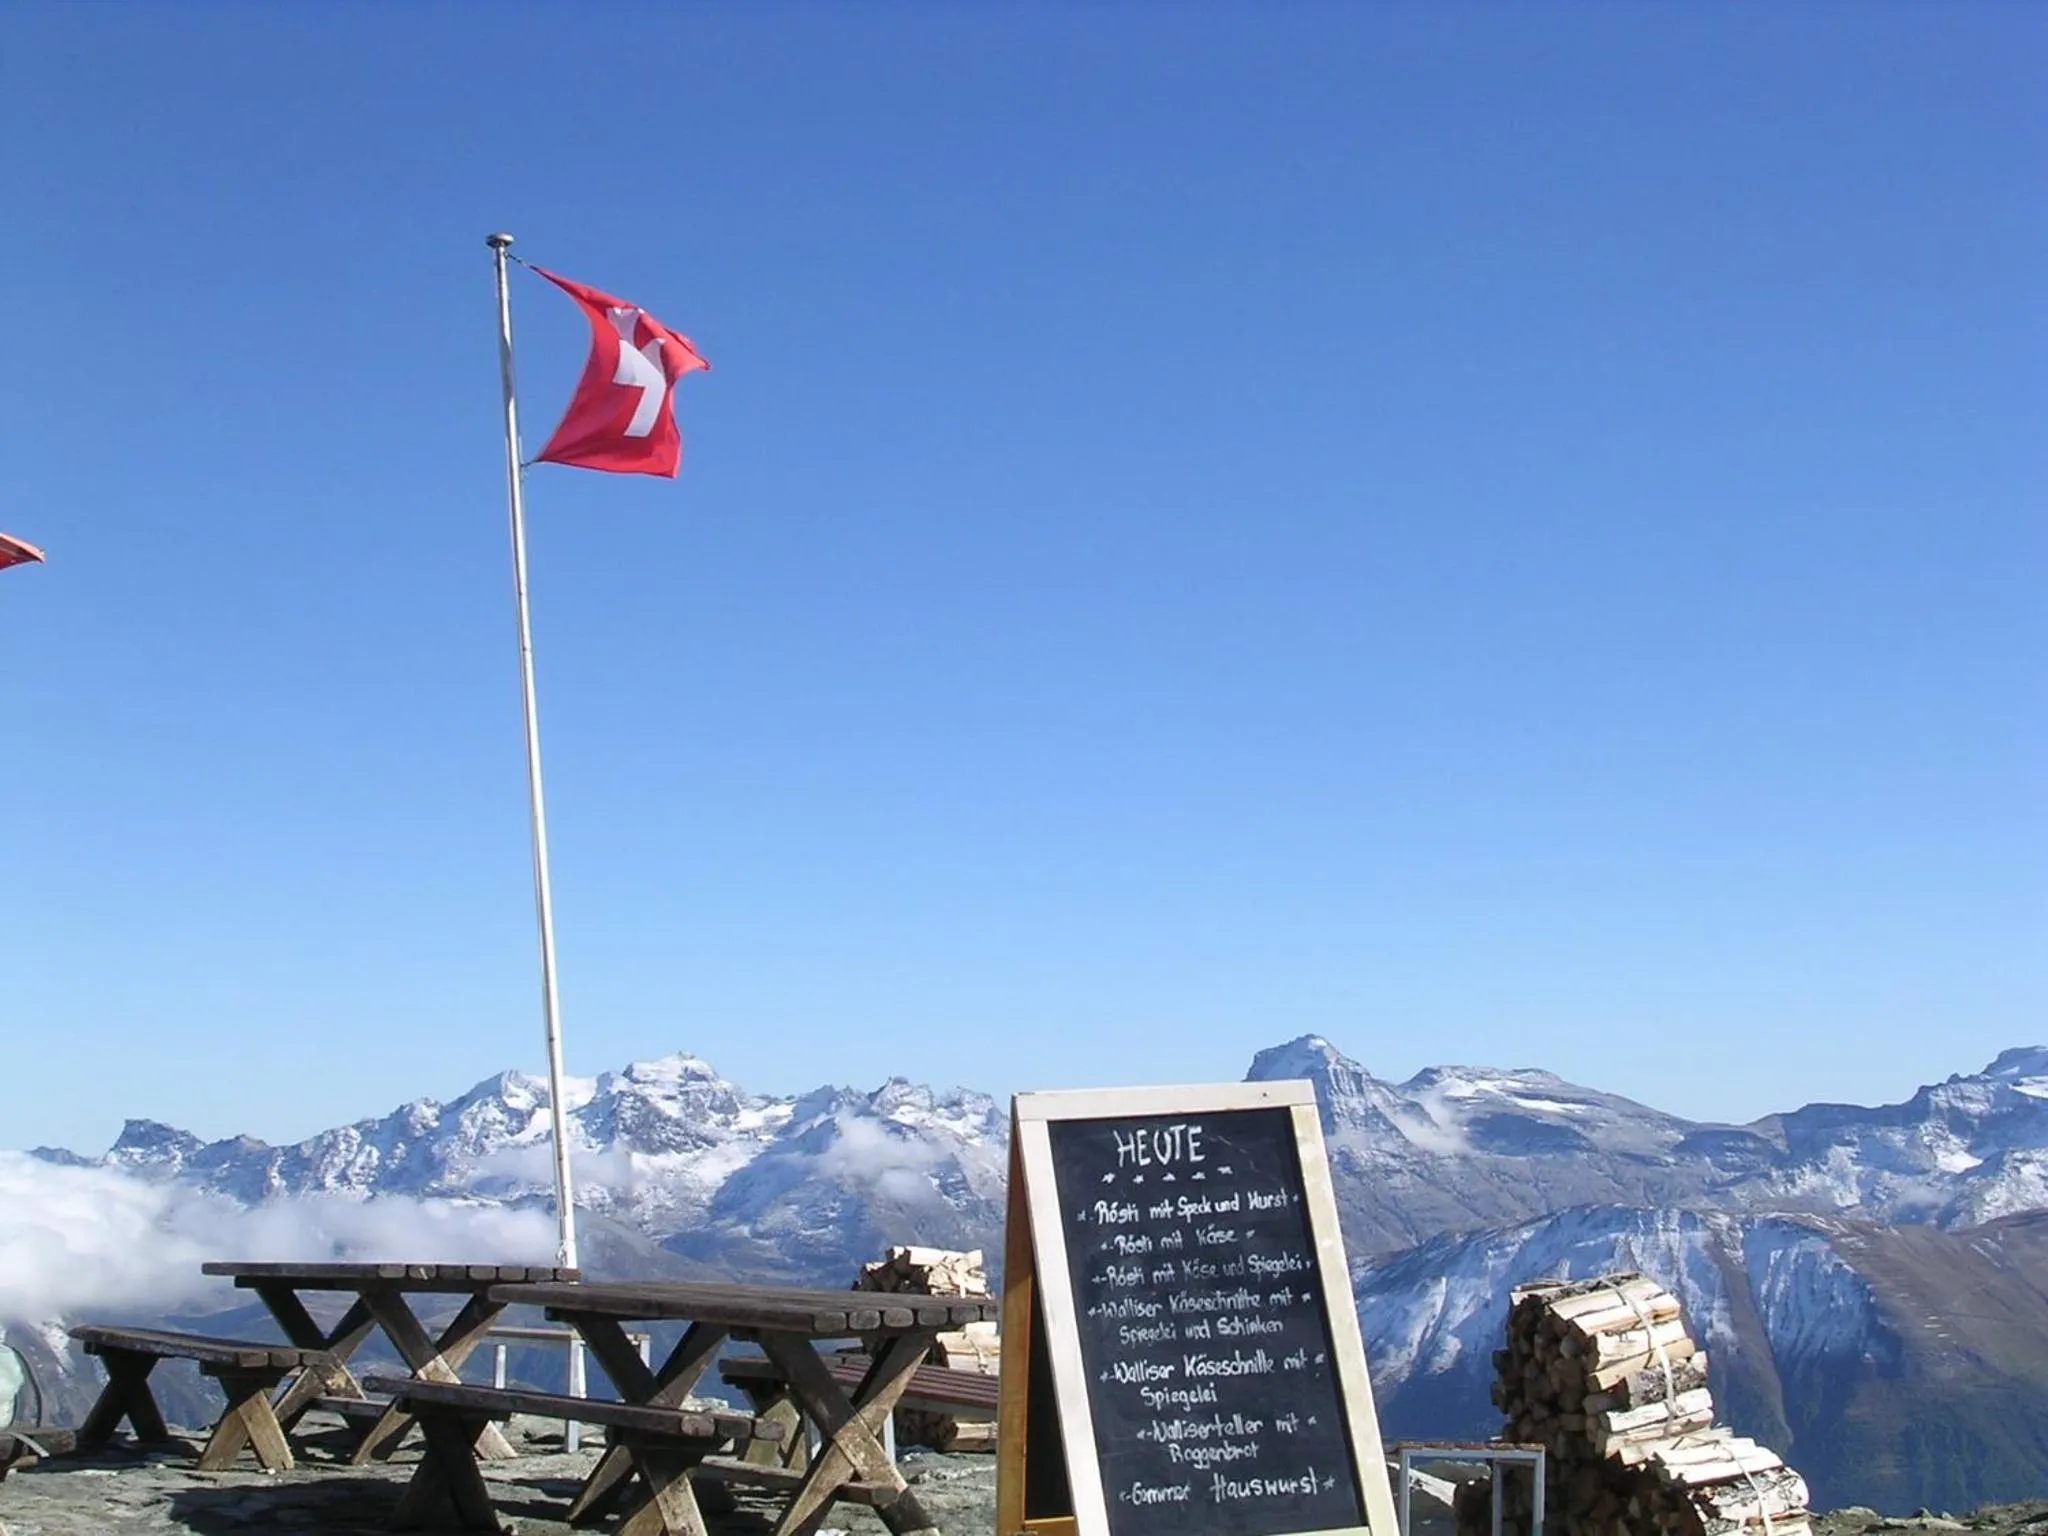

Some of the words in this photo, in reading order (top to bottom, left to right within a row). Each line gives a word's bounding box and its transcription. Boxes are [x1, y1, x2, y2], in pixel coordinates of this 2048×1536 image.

[1113, 1124, 1205, 1167] HEUTE
[1150, 1199, 1173, 1219] mit
[1177, 1194, 1212, 1223] Speck
[1215, 1192, 1239, 1212] und
[1248, 1187, 1287, 1210] Wurst
[1161, 1230, 1182, 1249] mit
[1153, 1262, 1175, 1283] mit
[1222, 1256, 1244, 1277] und
[1248, 1252, 1302, 1281] Spiegelei
[1102, 1293, 1163, 1319] Walliser
[1269, 1287, 1293, 1305] mit
[1120, 1318, 1176, 1348] Spiegelei
[1185, 1319, 1211, 1340] und
[1217, 1314, 1283, 1336] Schinken
[1113, 1360, 1174, 1383] Walliser
[1284, 1348, 1307, 1369] mit
[1140, 1383, 1217, 1411] Spiegelei
[1153, 1413, 1263, 1442] Walliserteller
[1276, 1412, 1299, 1433] mit
[1168, 1440, 1259, 1469] Roggenbrot
[1210, 1466, 1317, 1503] Hauswurst
